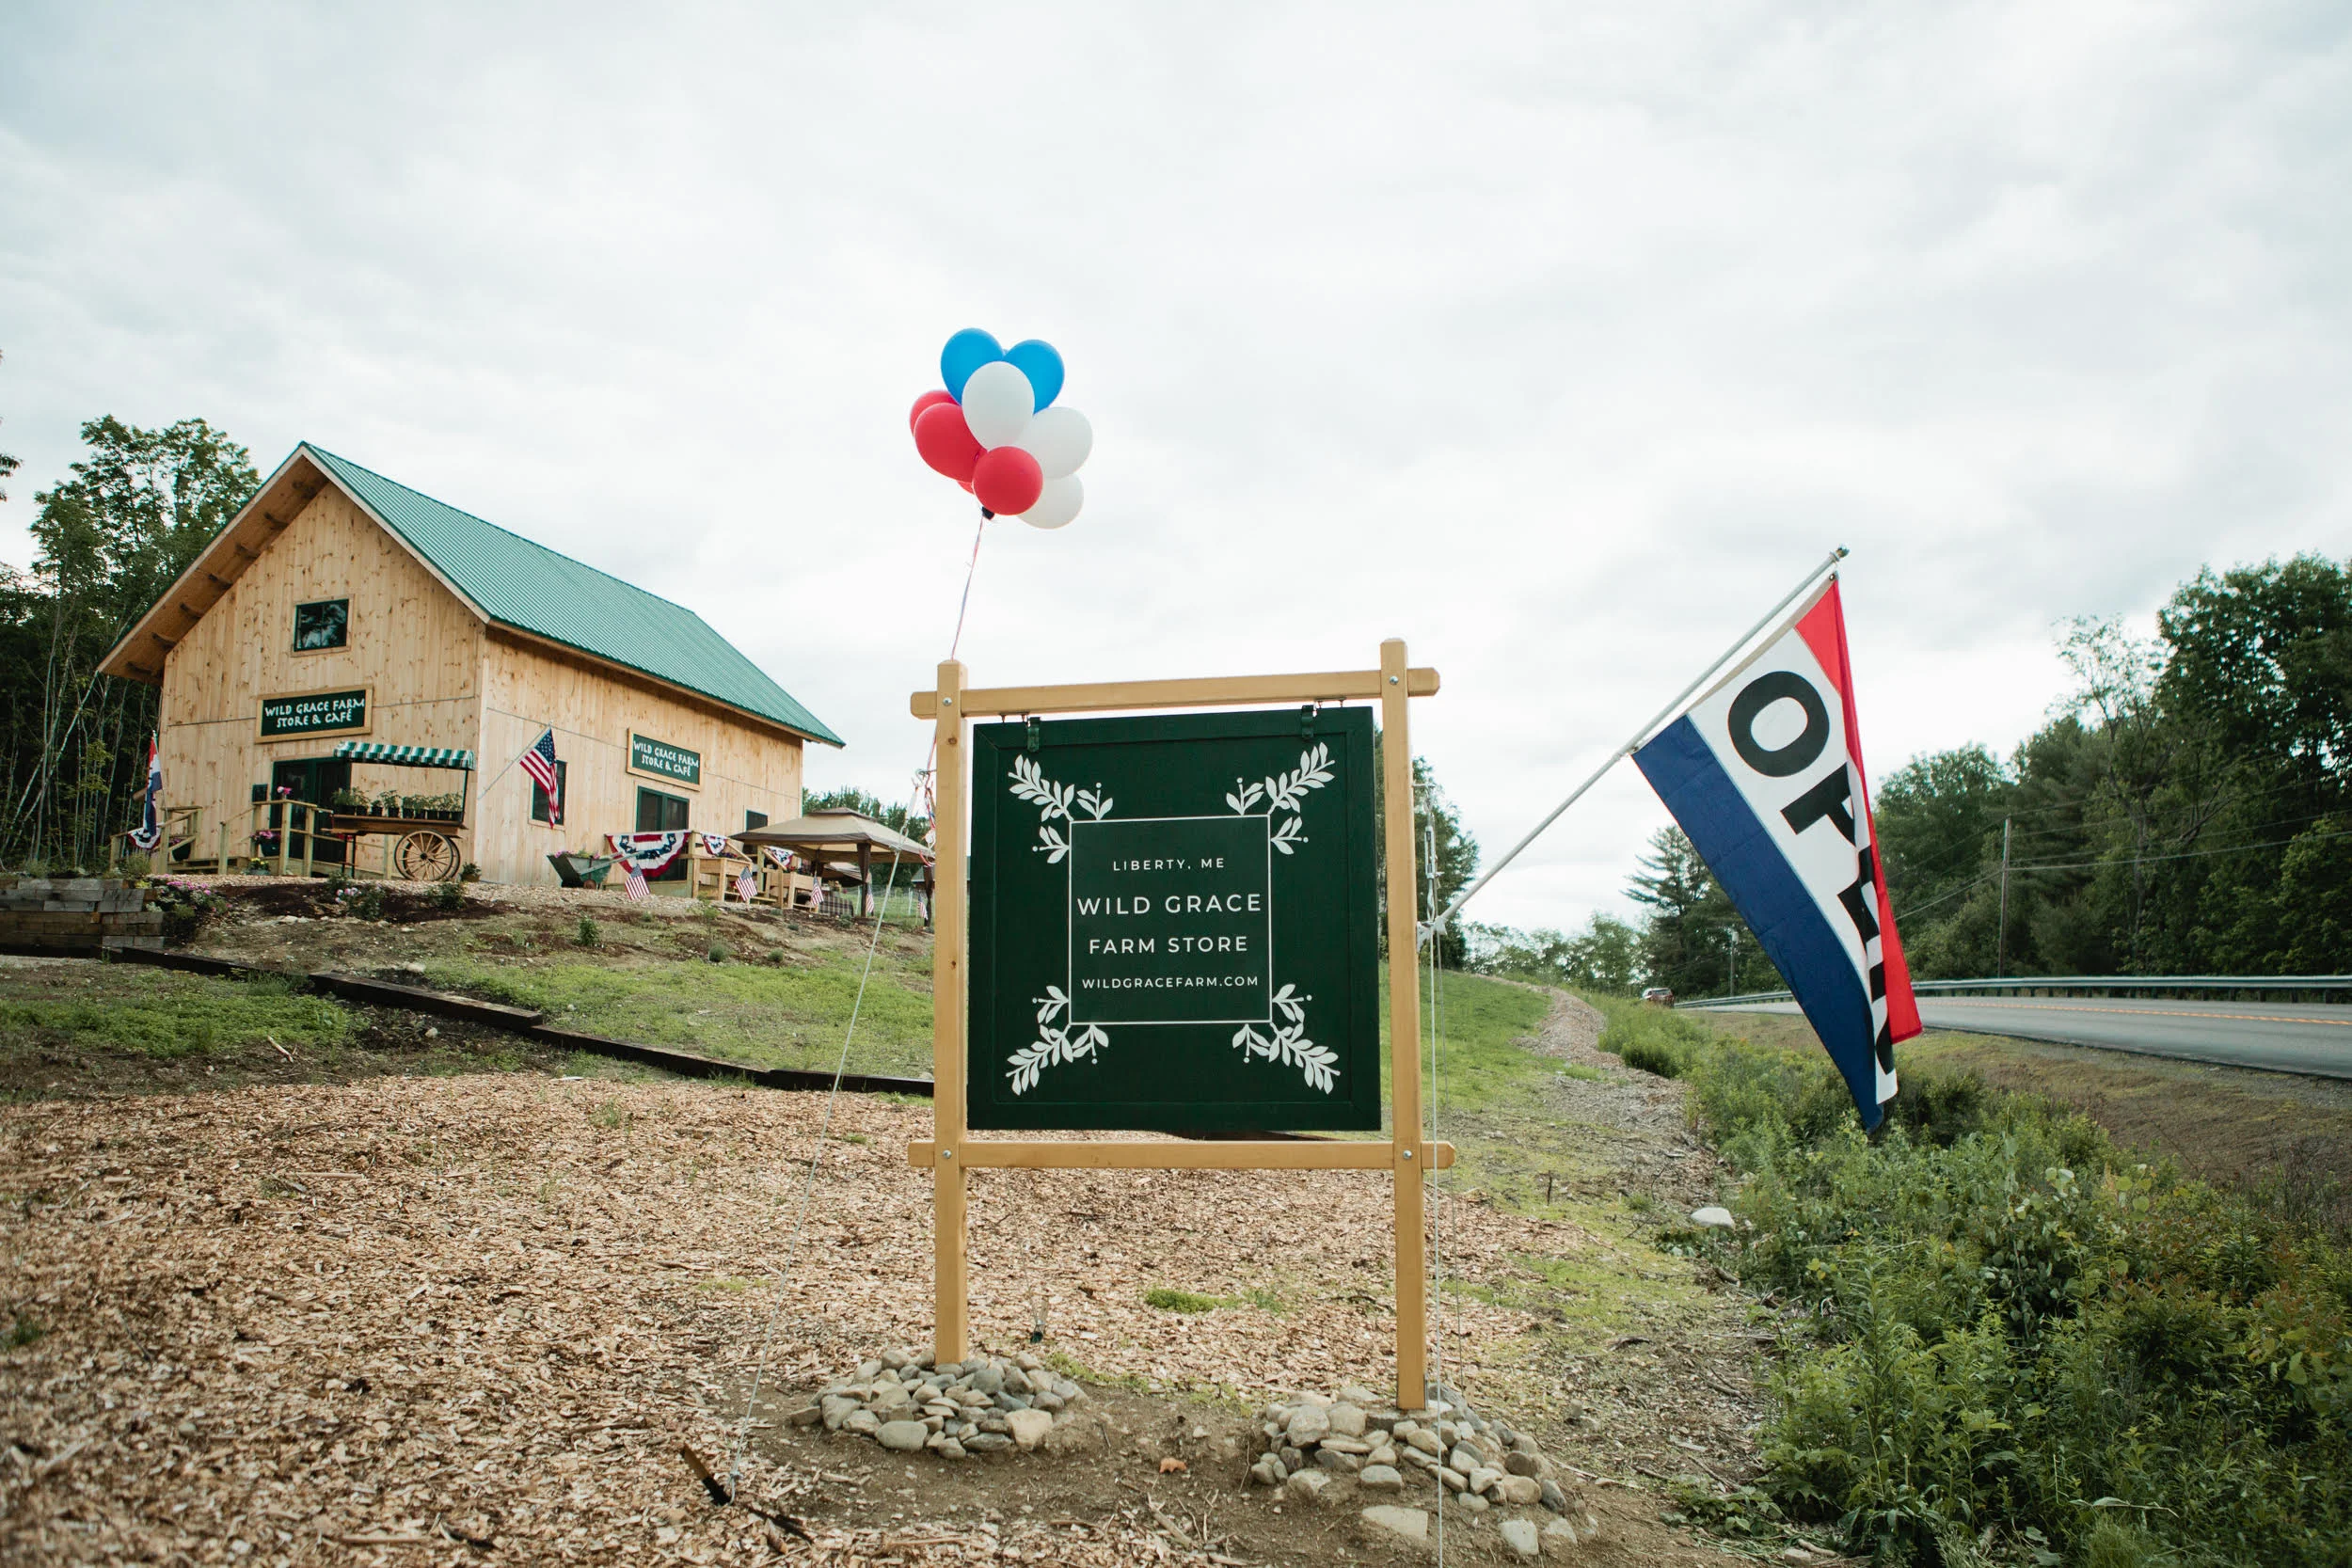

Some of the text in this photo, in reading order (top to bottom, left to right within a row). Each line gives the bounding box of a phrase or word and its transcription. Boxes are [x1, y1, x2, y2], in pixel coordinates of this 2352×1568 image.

[264, 698, 365, 717] WILD GRACE FARM
[277, 708, 352, 728] STORE & CAFÉ
[633, 740, 699, 768] WILD GRACE FARM
[642, 754, 663, 768] STORE
[665, 760, 672, 771] &
[1113, 858, 1224, 871] LIBERTY, ME
[1077, 894, 1261, 915] WILD GRACE
[1089, 936, 1248, 955] FARM STORE
[1082, 975, 1259, 989] WILDGRACEFARM.COM
